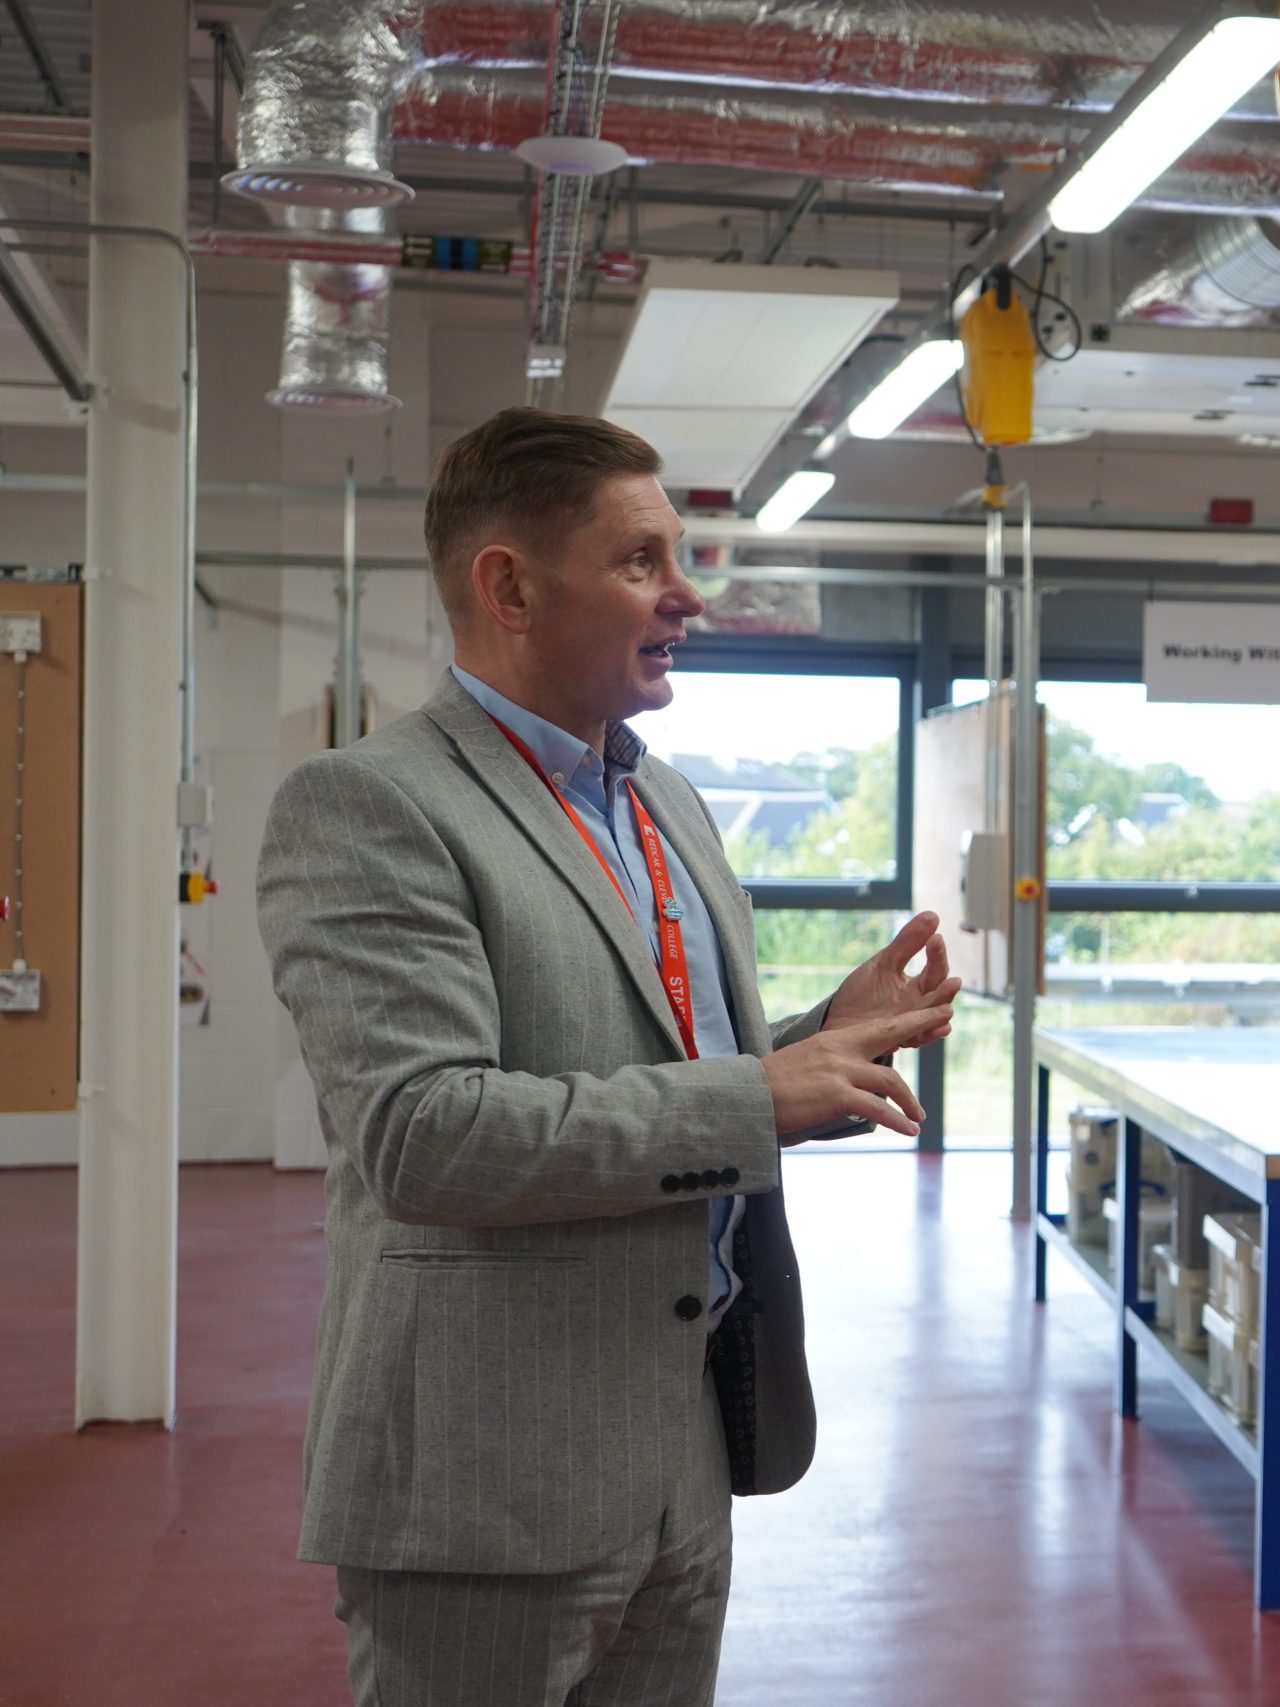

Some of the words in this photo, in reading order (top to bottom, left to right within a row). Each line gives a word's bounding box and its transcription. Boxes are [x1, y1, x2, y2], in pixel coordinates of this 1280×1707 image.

[1163, 642, 1242, 663] Working
[648, 838, 661, 867] REDCAR
[667, 924, 679, 960] COLLEGE
